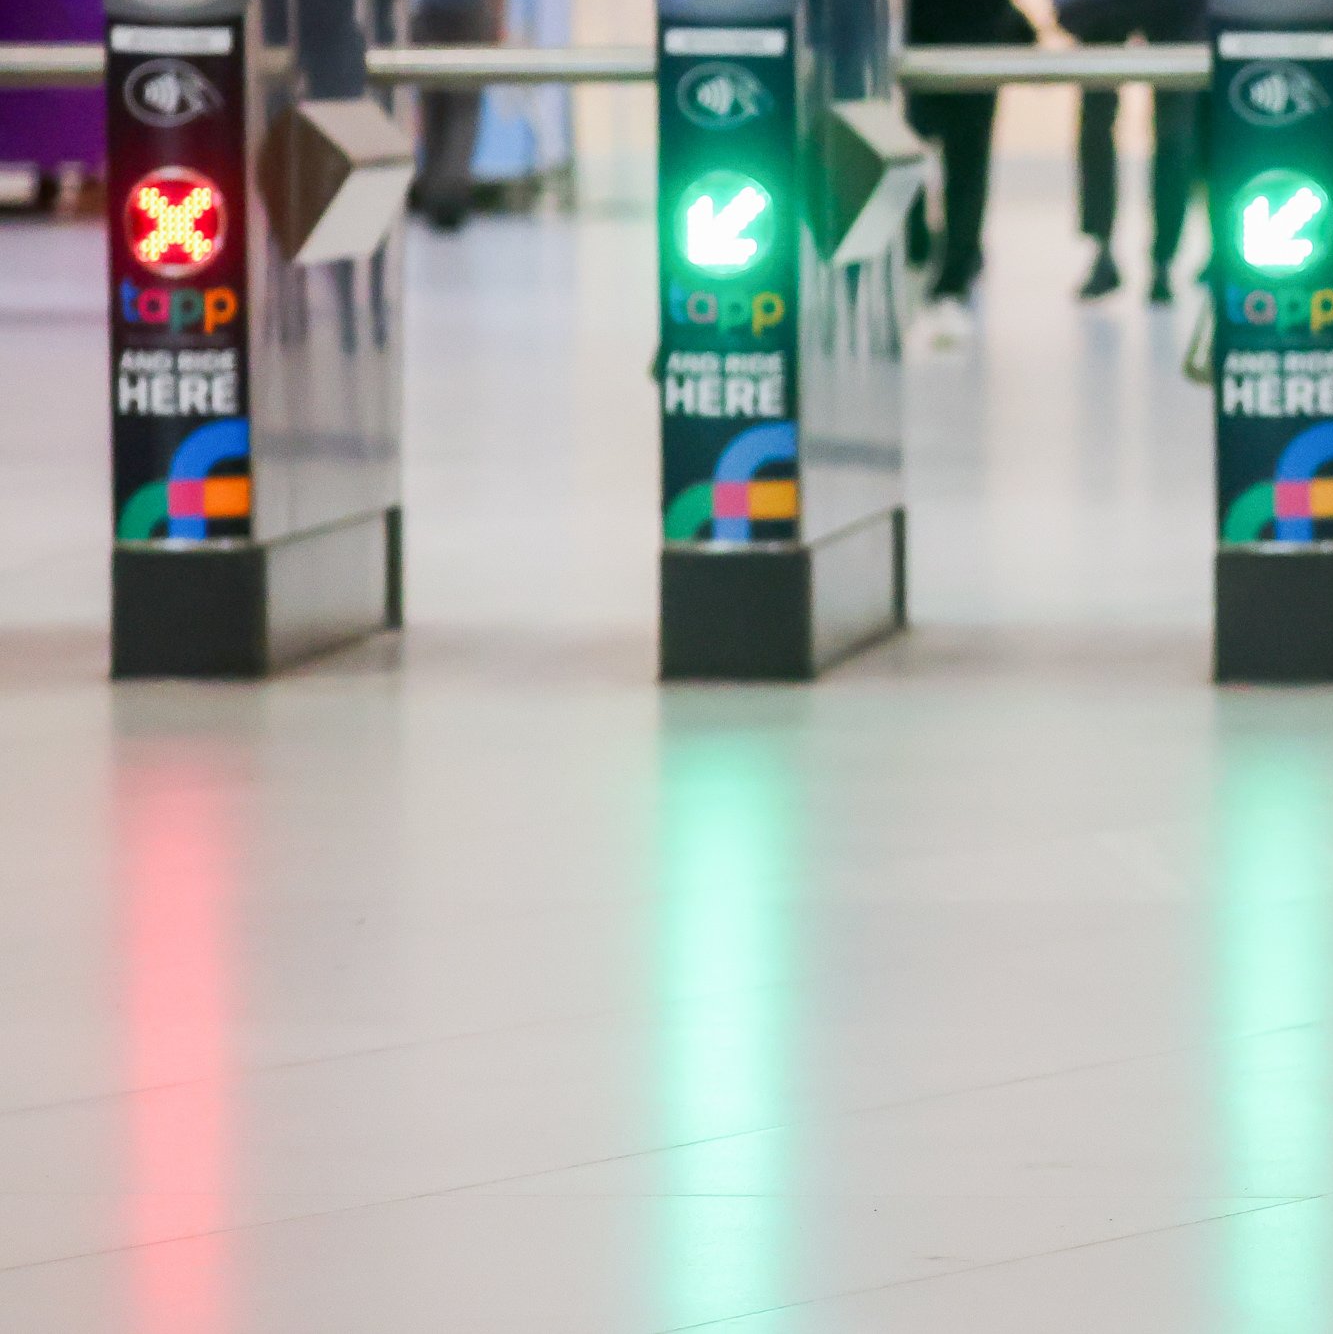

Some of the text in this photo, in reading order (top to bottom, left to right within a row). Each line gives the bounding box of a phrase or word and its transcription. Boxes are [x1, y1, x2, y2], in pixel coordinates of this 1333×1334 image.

[119, 278, 237, 336] tapp
[669, 280, 785, 337] tapp
[119, 374, 238, 416] HERE
[665, 374, 784, 417] HERE
